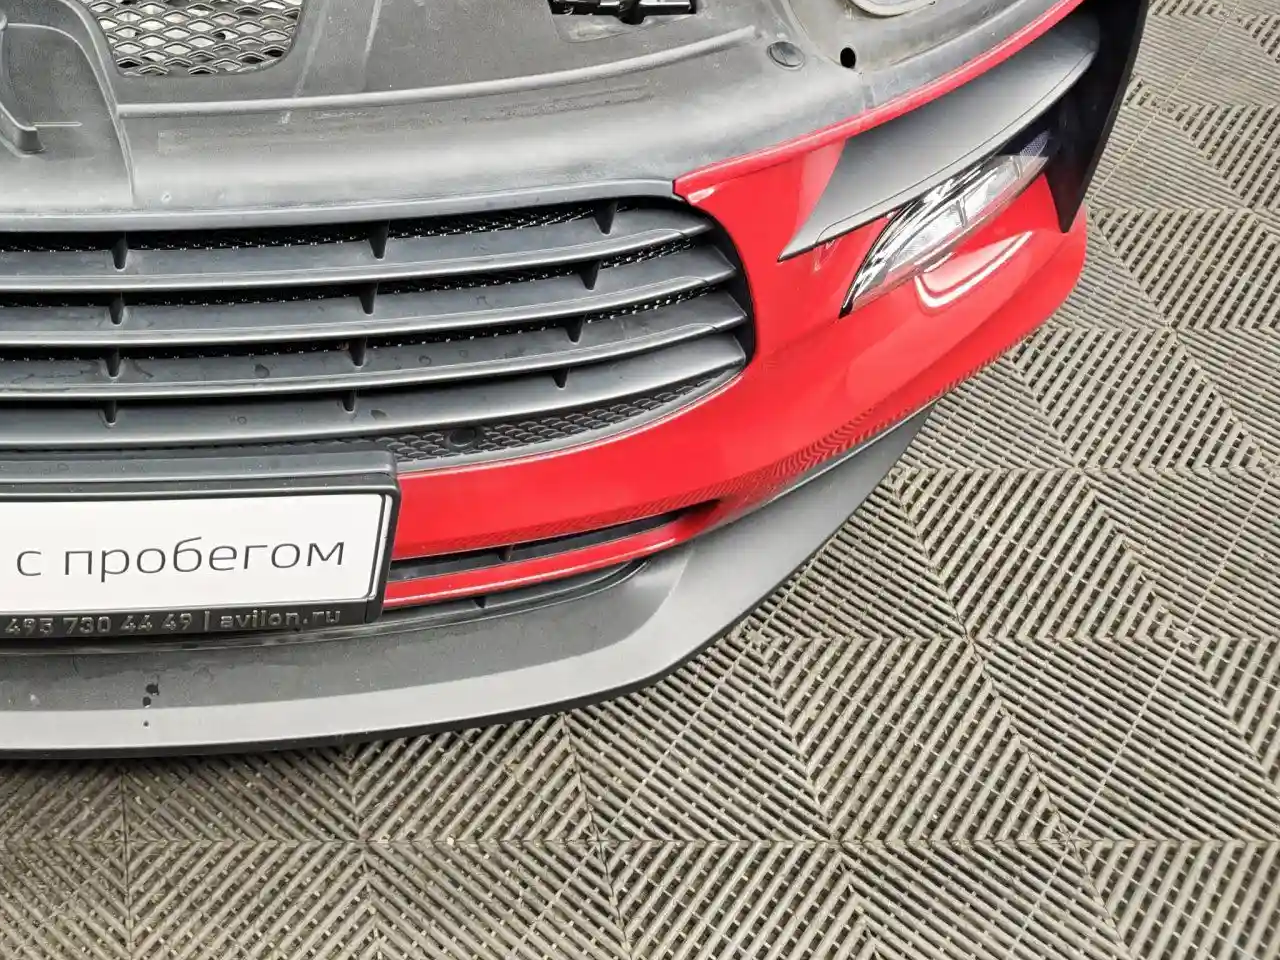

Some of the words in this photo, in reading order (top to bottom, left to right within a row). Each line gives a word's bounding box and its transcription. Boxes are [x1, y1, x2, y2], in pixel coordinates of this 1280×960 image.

[16, 550, 42, 577] с
[64, 536, 346, 583] пробегом
[4, 617, 56, 637] 495
[62, 615, 113, 635] 730
[120, 613, 154, 632] 44
[160, 611, 194, 632] 49
